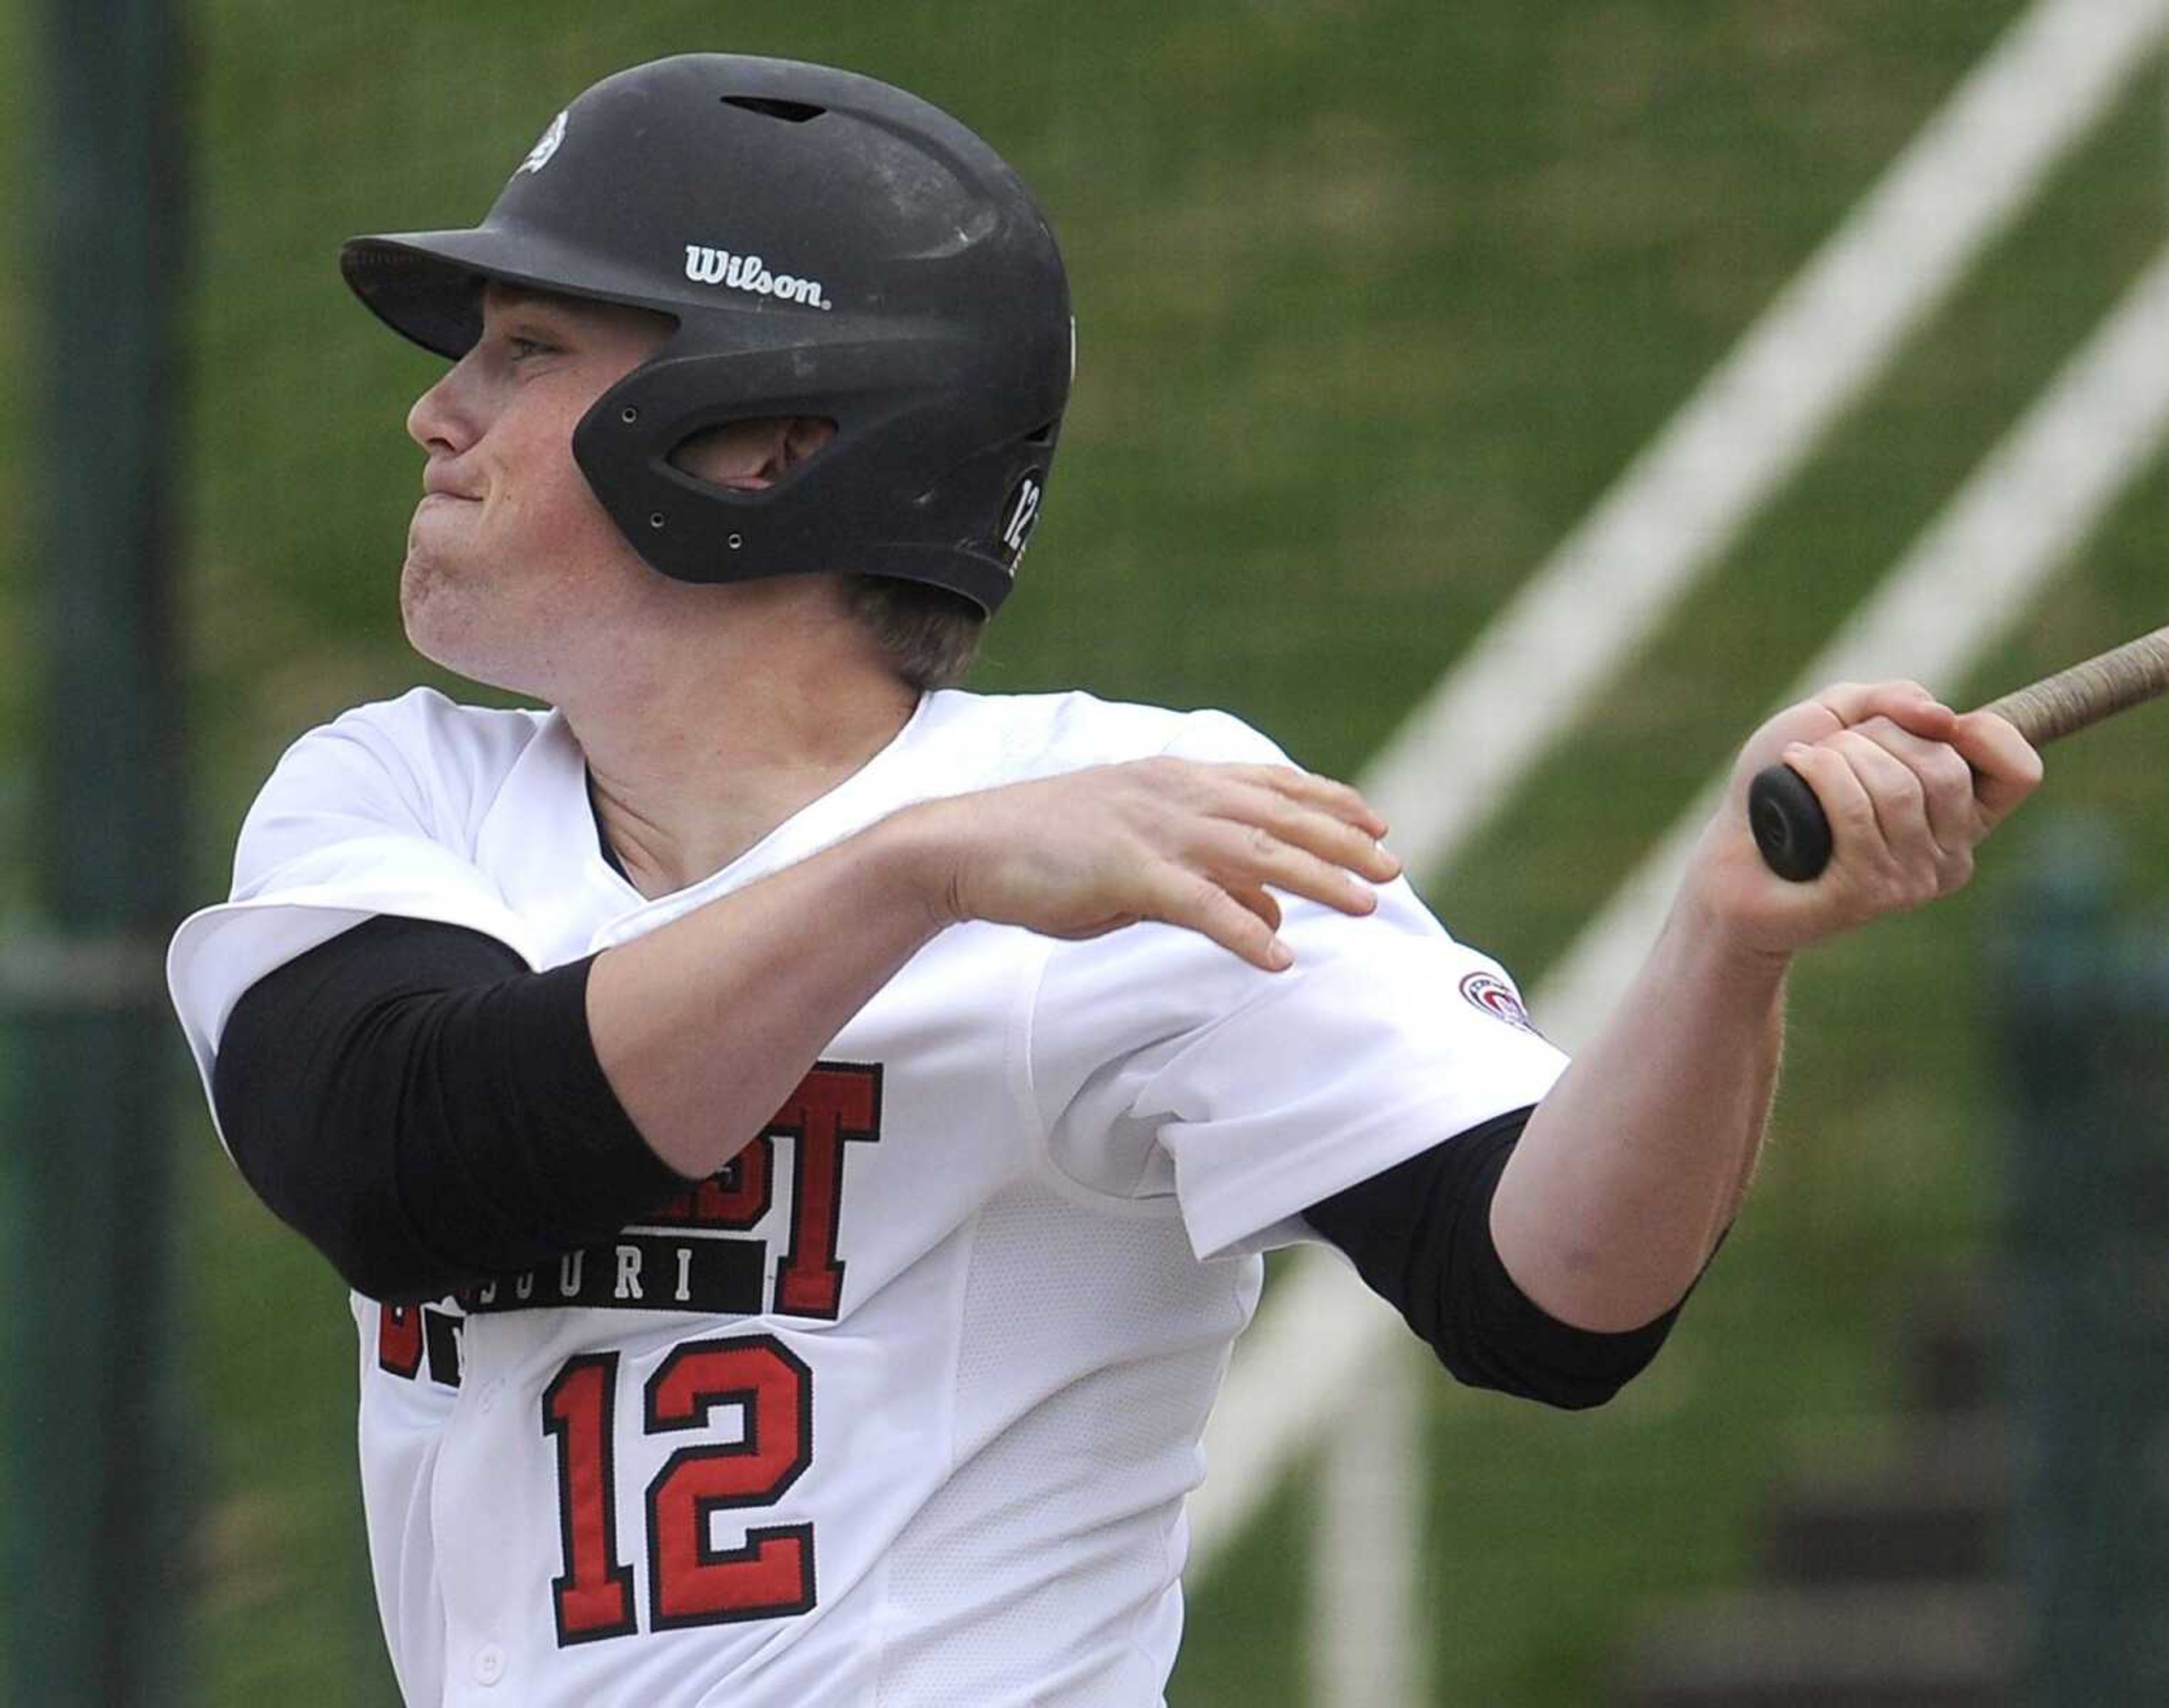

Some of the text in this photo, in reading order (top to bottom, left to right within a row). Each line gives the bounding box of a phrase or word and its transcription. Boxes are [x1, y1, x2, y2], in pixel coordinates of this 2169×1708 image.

[685, 244, 821, 308] Wilson
[1003, 479, 1040, 550] 12
[542, 1333, 817, 1649] 12
